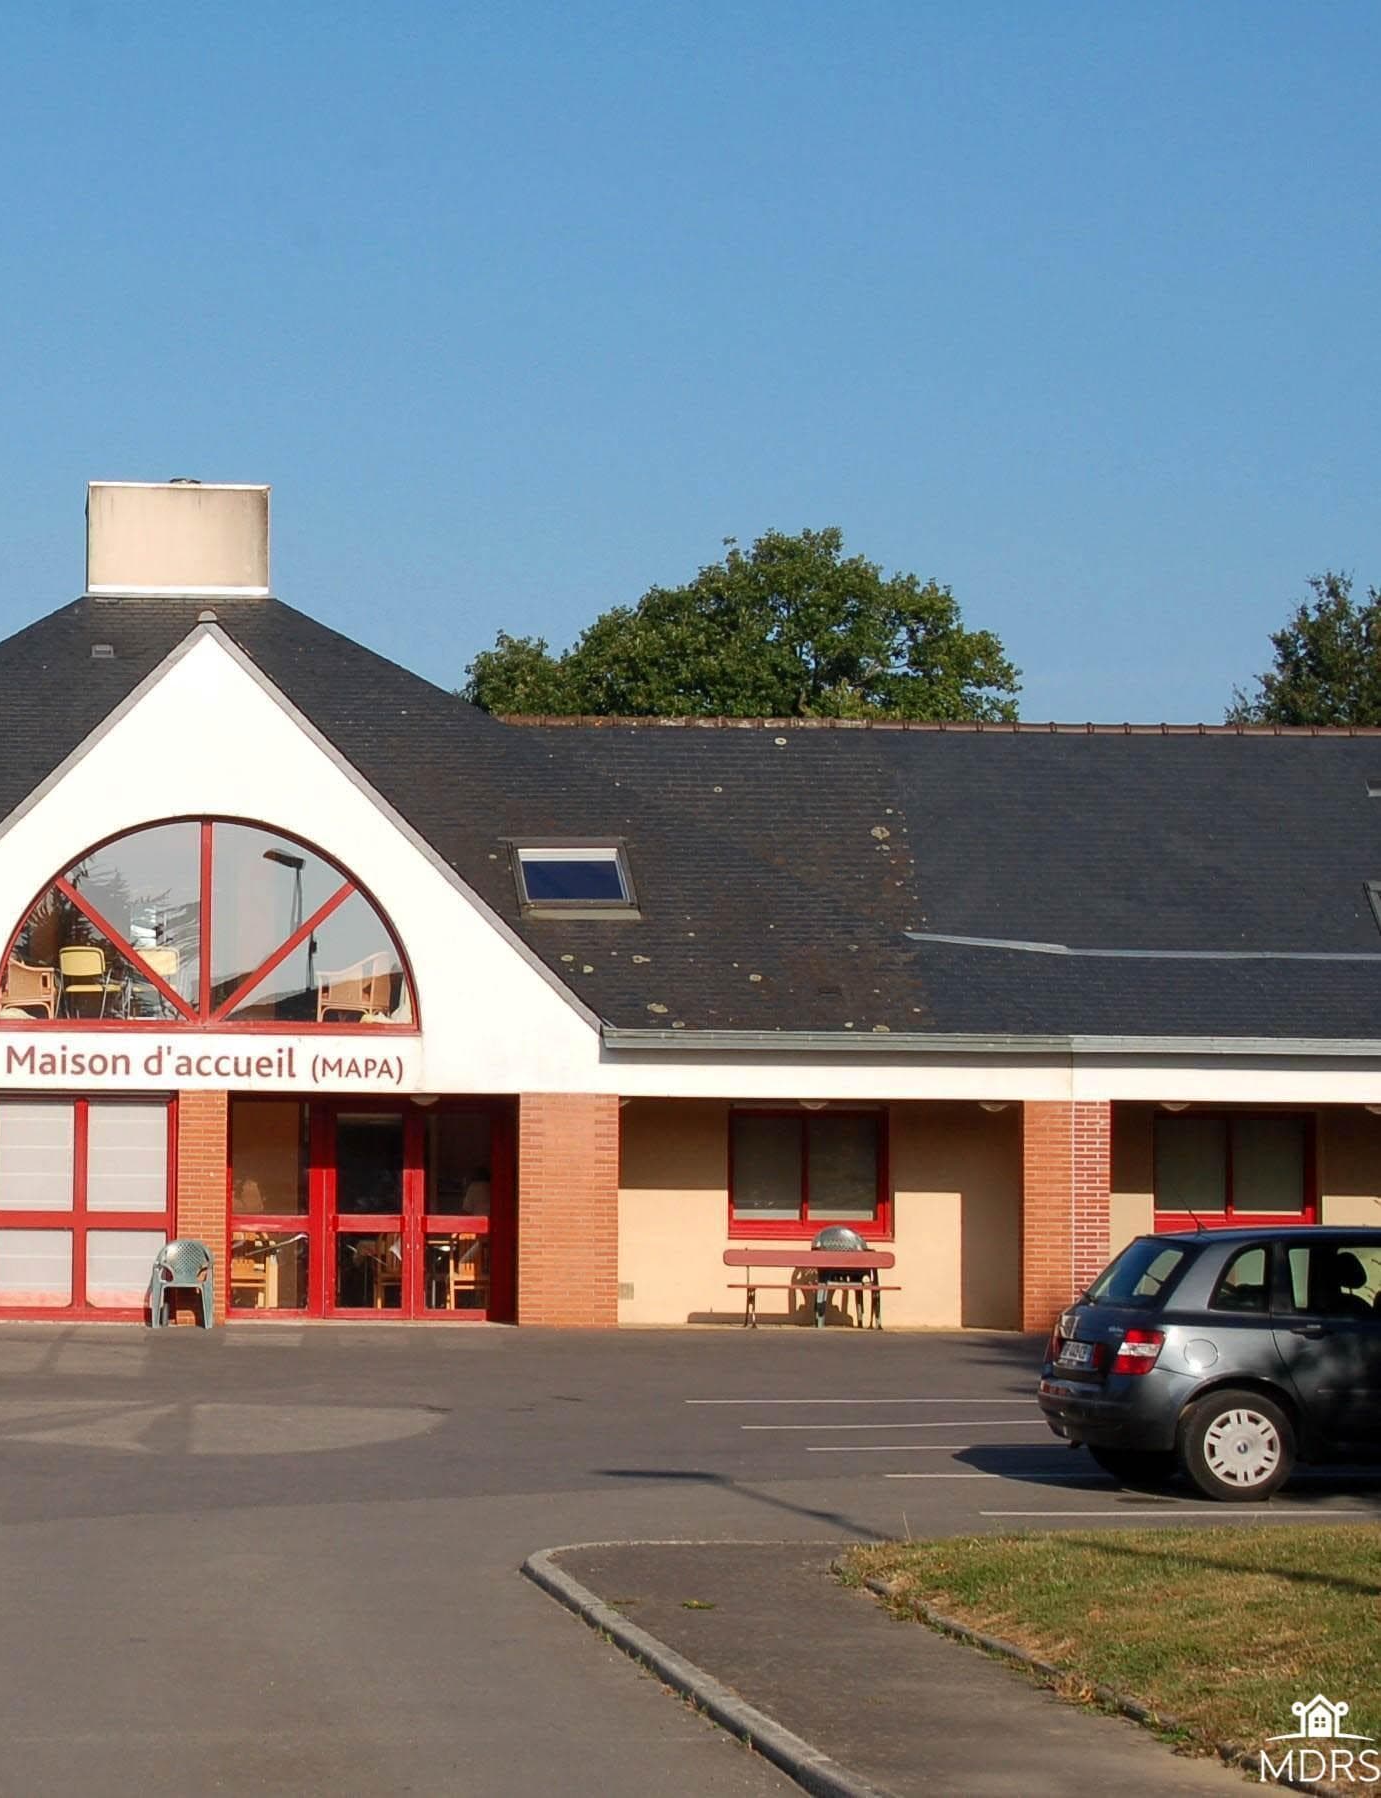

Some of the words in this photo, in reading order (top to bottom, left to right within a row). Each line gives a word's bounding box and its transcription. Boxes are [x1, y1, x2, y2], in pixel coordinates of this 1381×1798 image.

[5, 1045, 130, 1077] Maison
[143, 1045, 296, 1079] d'accueil
[311, 1055, 405, 1084] (MAPA)
